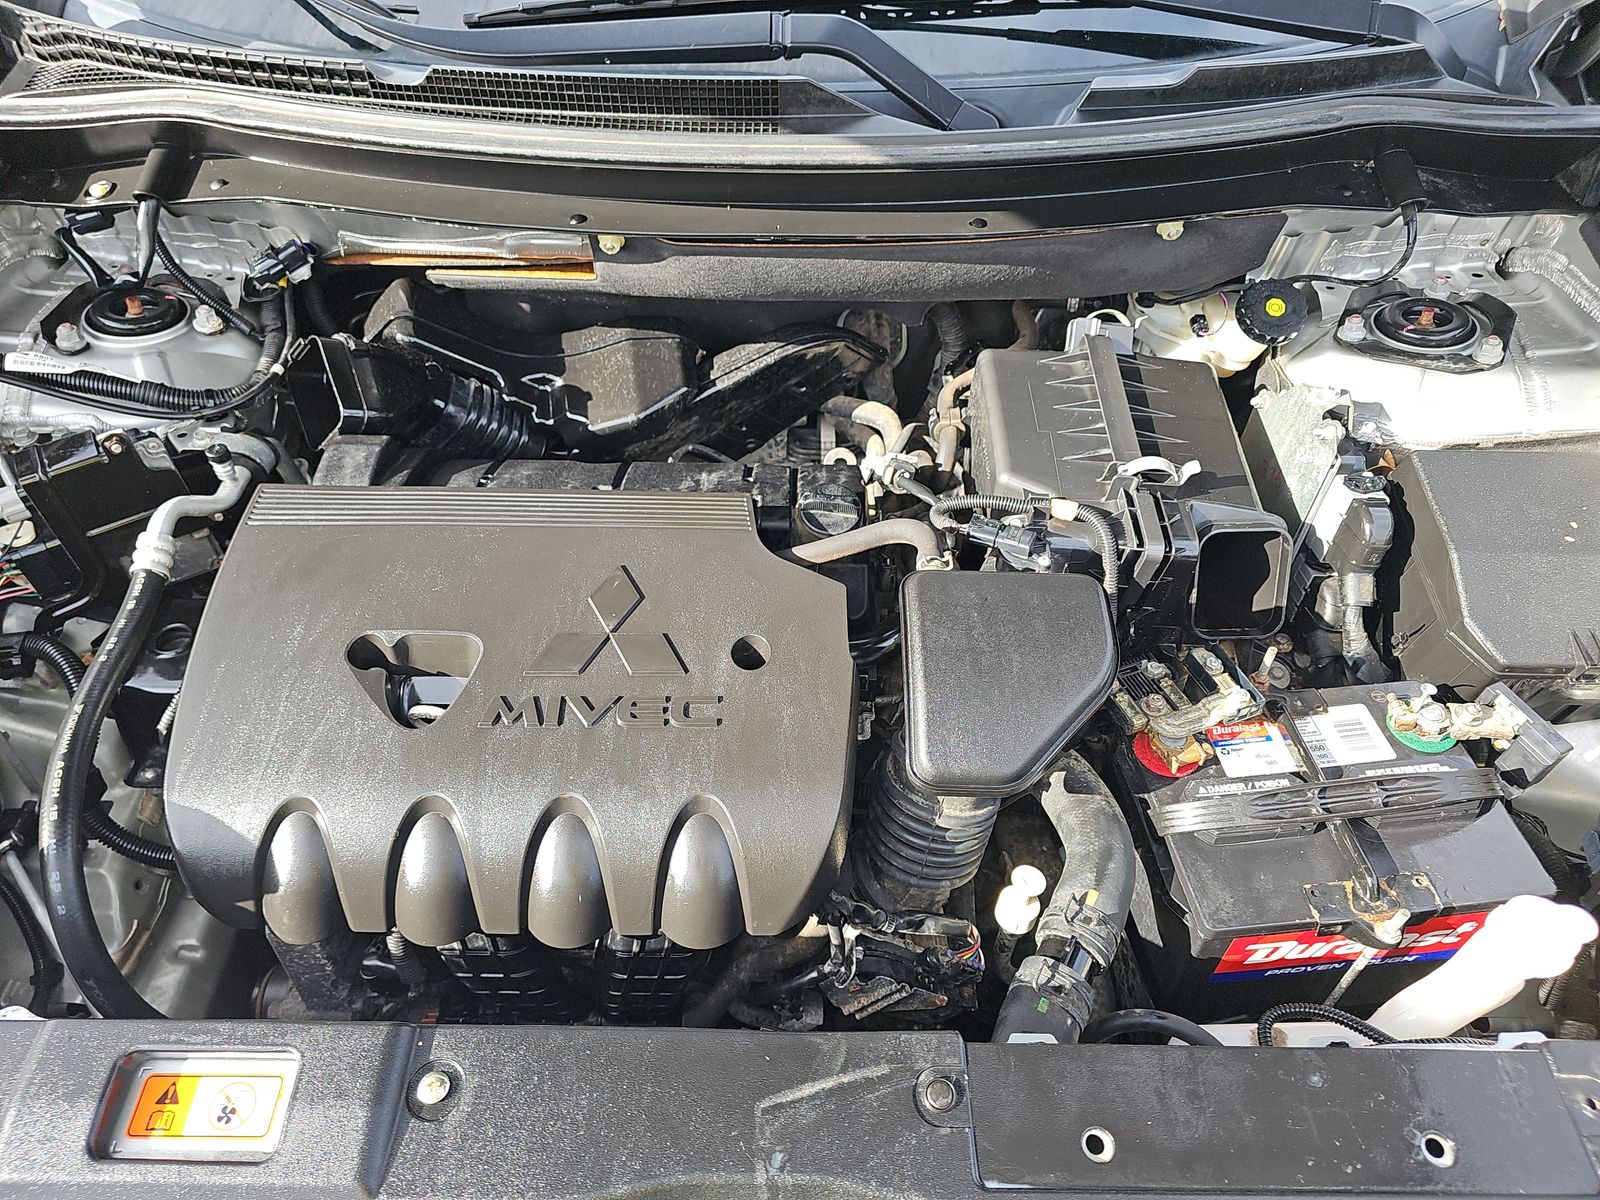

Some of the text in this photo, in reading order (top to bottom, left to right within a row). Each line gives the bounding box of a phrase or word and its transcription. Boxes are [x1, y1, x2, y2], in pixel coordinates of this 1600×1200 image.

[478, 695, 724, 728] MIVEC
[60, 713, 79, 755] YOKOHAMA
[1212, 720, 1263, 736] Duralast
[1206, 782, 1245, 795] DANGER
[1255, 778, 1291, 790] POISON
[49, 804, 59, 821] 15
[1243, 921, 1479, 965] Duraast
[1264, 954, 1420, 977] PROVEN OUGH
